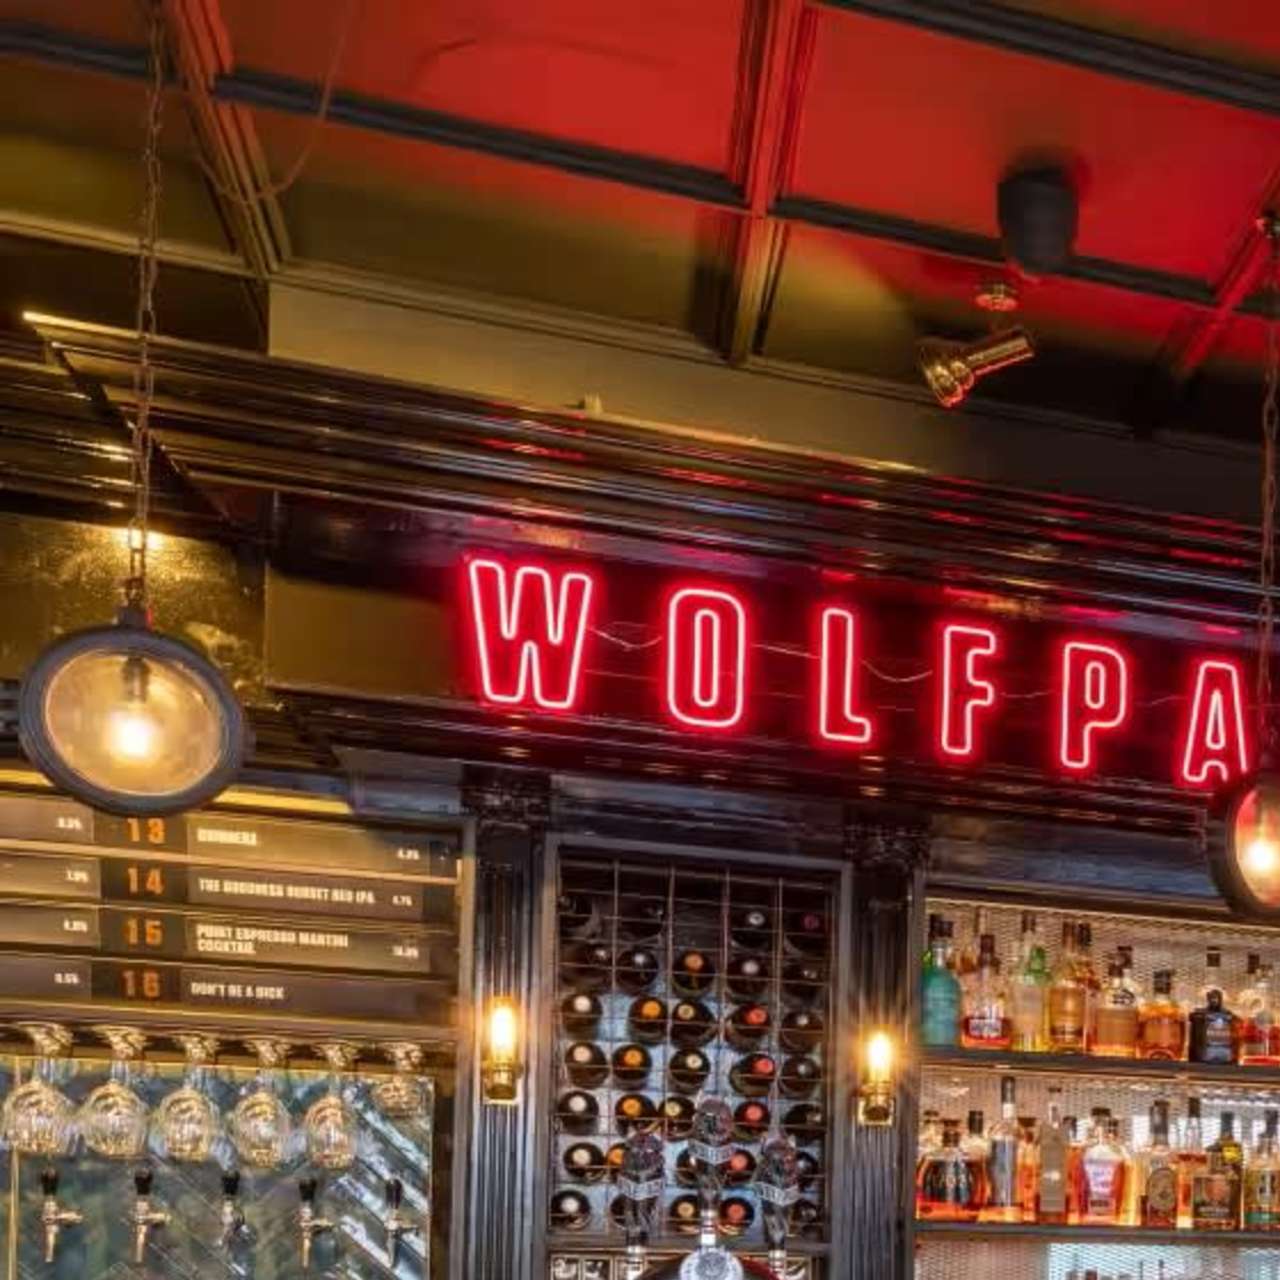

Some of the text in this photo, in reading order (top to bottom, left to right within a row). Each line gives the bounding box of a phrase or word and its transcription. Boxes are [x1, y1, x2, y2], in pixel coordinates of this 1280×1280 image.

[126, 817, 165, 844] 13
[127, 867, 164, 895] 14
[123, 917, 163, 946] 15
[298, 931, 349, 948] MARTINI
[122, 969, 160, 998] 16
